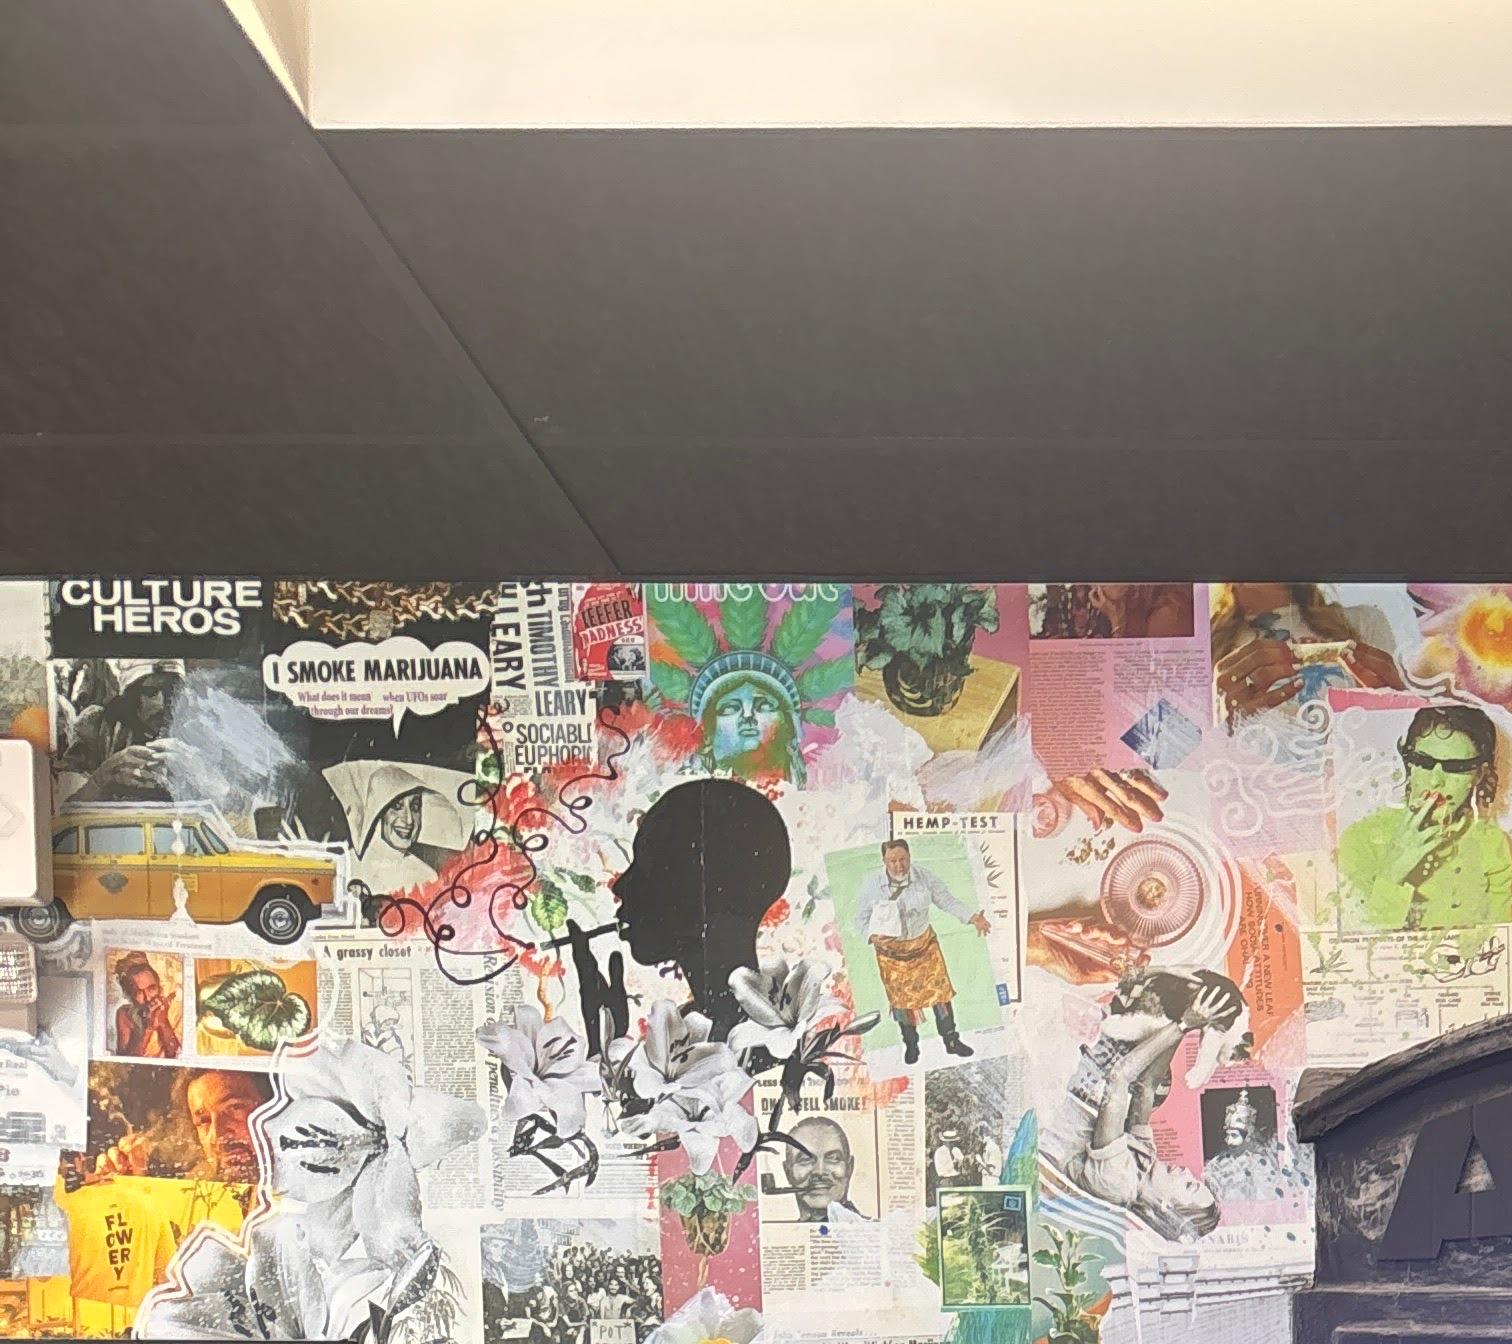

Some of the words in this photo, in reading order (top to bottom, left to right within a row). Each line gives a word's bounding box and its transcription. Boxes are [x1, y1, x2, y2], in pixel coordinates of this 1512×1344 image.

[62, 579, 263, 607] CULTURE
[93, 607, 242, 636] HEROS
[491, 606, 527, 690] LEARY
[526, 610, 560, 687] TIMOTHY
[273, 662, 280, 684] I
[287, 659, 356, 683] SMOKE
[363, 657, 483, 682] MARIJUANA
[298, 691, 319, 702] What
[534, 689, 587, 717] LEARY
[903, 816, 999, 831] HEMP-TEST
[336, 947, 374, 961] grassy
[378, 944, 413, 959] closet
[823, 1096, 867, 1112] SMOKE!
[104, 1211, 128, 1231] FL
[108, 1247, 131, 1266] ER
[113, 1265, 125, 1281] Y
[599, 1325, 623, 1340] POT
